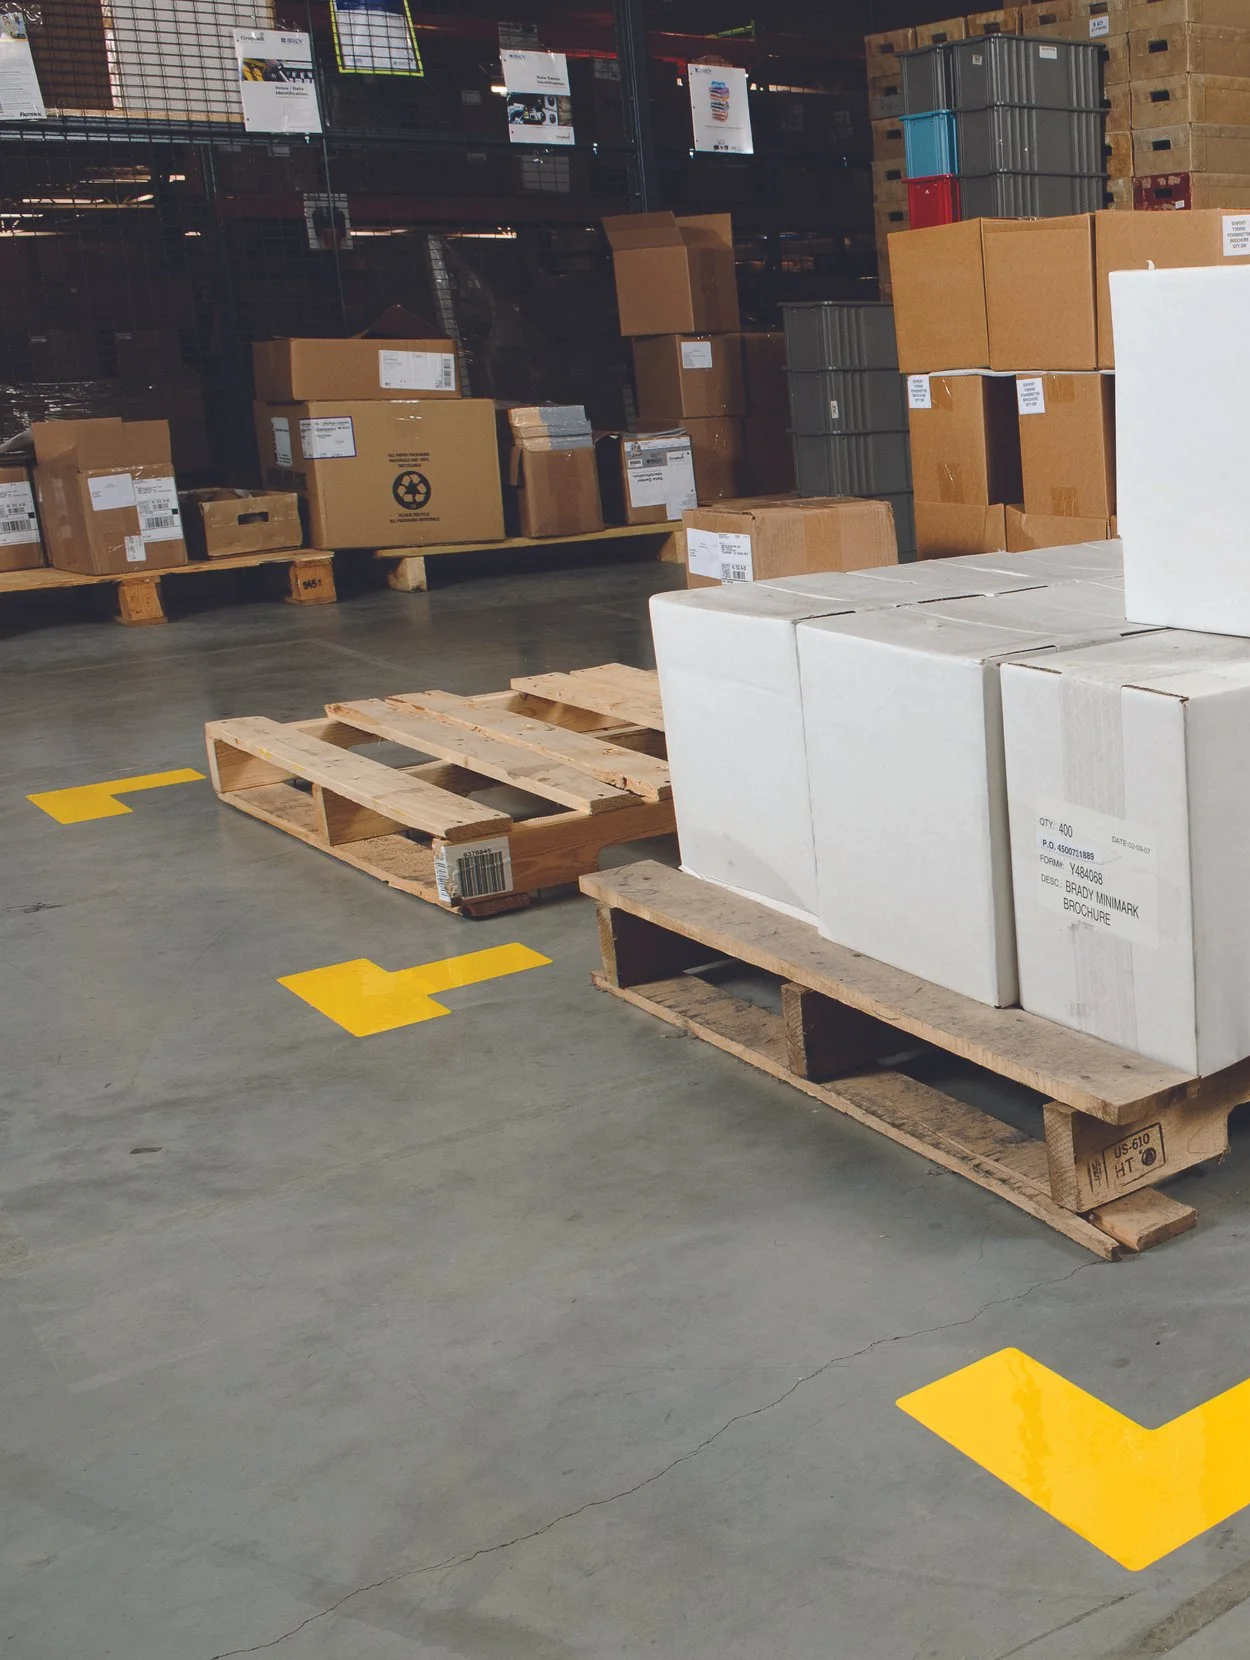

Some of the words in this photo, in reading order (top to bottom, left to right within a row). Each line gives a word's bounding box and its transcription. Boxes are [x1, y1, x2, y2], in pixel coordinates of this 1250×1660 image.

[1058, 823, 1073, 838] 400
[1042, 839, 1056, 851] P.O.
[1057, 844, 1095, 861] 4500731889
[1112, 836, 1151, 855] DATE:02-09-07
[1040, 854, 1065, 869] FORM#:
[1070, 862, 1103, 885] Y484068
[1063, 897, 1111, 926] BROCHURE
[1065, 880, 1094, 901] BRADY
[1096, 891, 1139, 918] MINIMARK
[1114, 1132, 1150, 1159] US-610
[1115, 1157, 1134, 1180] HT
